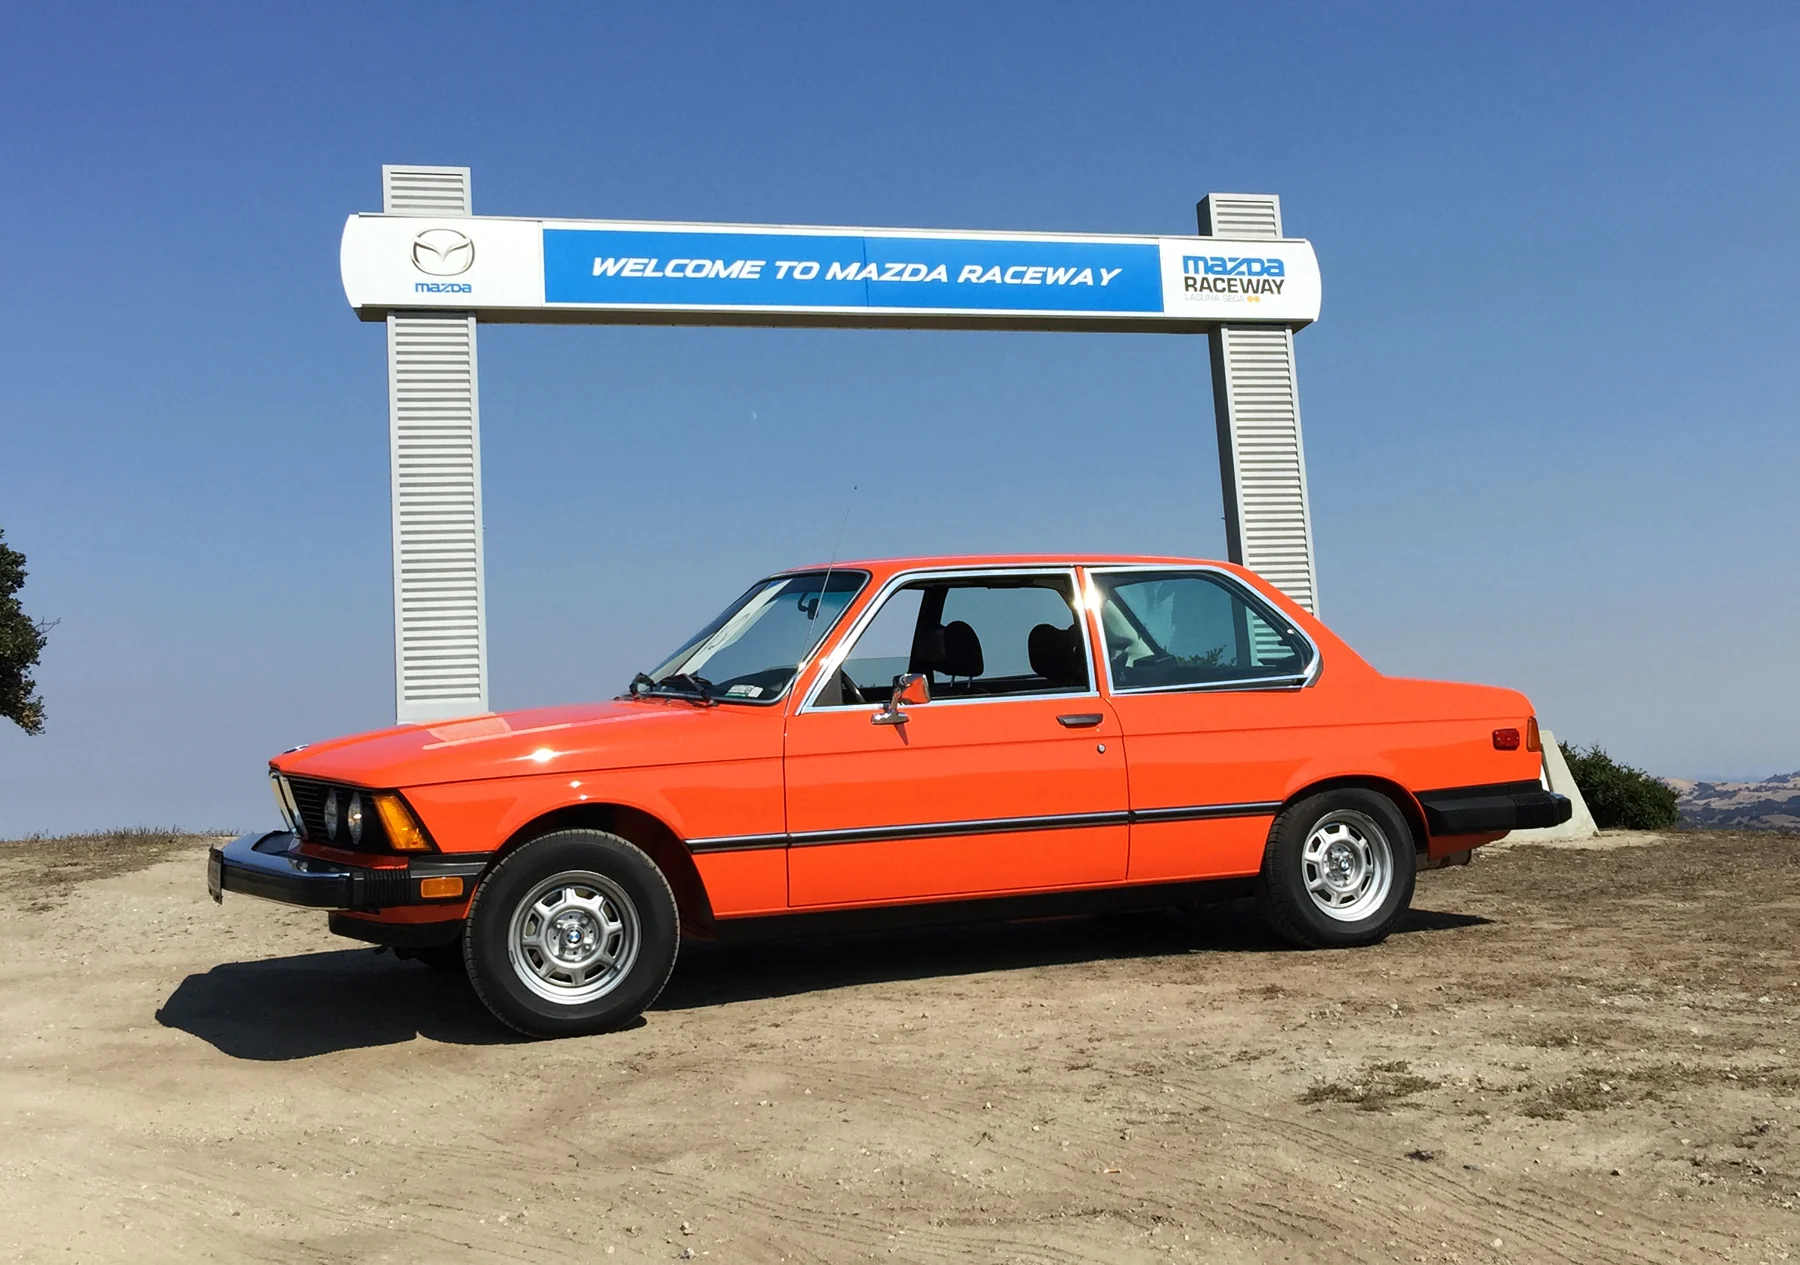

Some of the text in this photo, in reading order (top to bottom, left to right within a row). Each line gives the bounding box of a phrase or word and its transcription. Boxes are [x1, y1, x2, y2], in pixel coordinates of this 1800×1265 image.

[592, 257, 1123, 286] WELCOME TO MAZDA RACEWAY
[1182, 255, 1285, 277] mazda
[415, 282, 472, 293] mazda
[1184, 276, 1285, 295] RACEWAY
[1184, 293, 1245, 303] LAGUNA SECA
